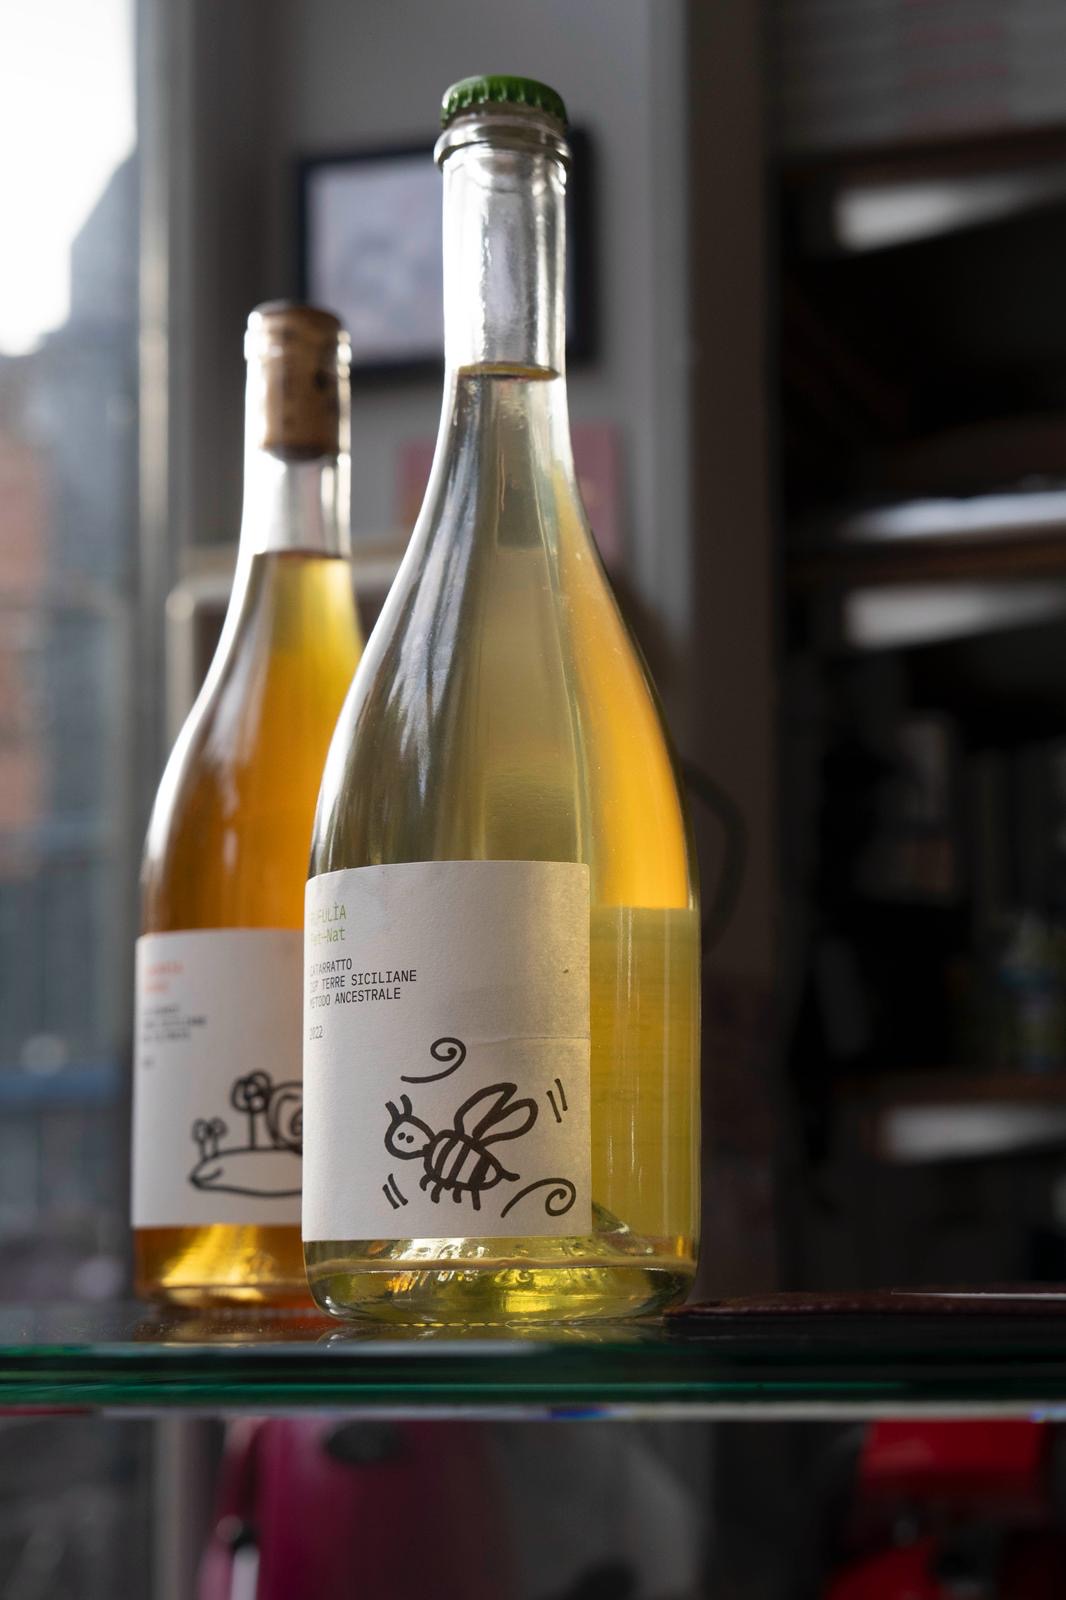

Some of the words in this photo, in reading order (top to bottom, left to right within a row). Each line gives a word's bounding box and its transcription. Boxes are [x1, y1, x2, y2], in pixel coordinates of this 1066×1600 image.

[321, 975, 346, 990] TERRE
[351, 969, 417, 986] SICILIANE
[334, 987, 401, 1005] ANCESTRALE
